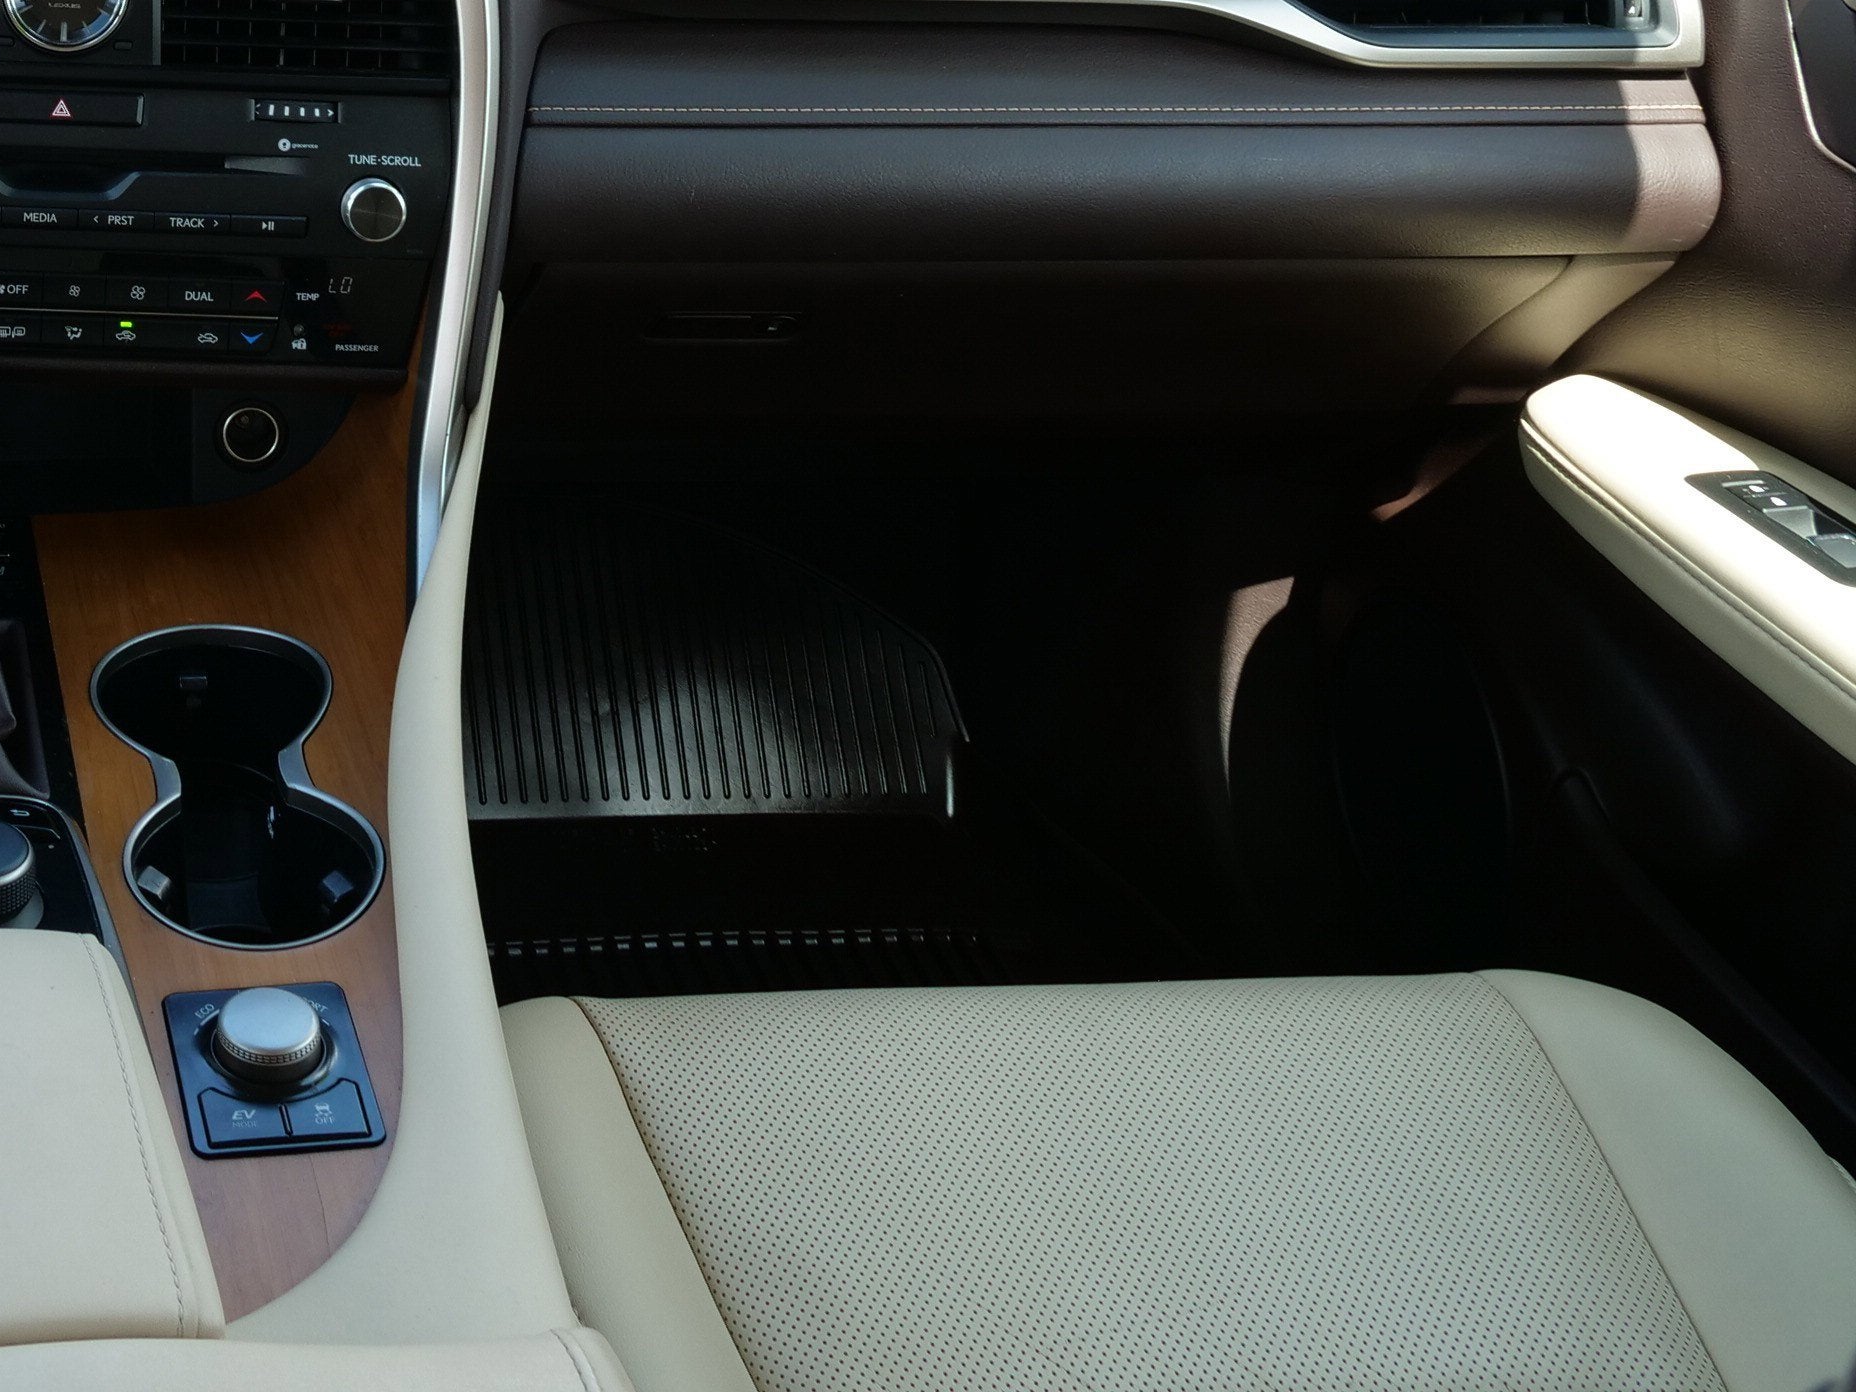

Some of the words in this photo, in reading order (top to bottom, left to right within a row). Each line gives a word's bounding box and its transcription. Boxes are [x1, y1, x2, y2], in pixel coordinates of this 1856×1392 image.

[23, 212, 58, 223] MEDIA
[108, 215, 134, 226] PRST
[170, 217, 205, 228] TRACK
[6, 284, 29, 294] OFF
[185, 290, 214, 302] DUAL
[296, 292, 320, 301] TEMP
[335, 343, 379, 352] PASSENGER
[194, 1004, 215, 1019] ECO
[232, 1109, 256, 1121] EV
